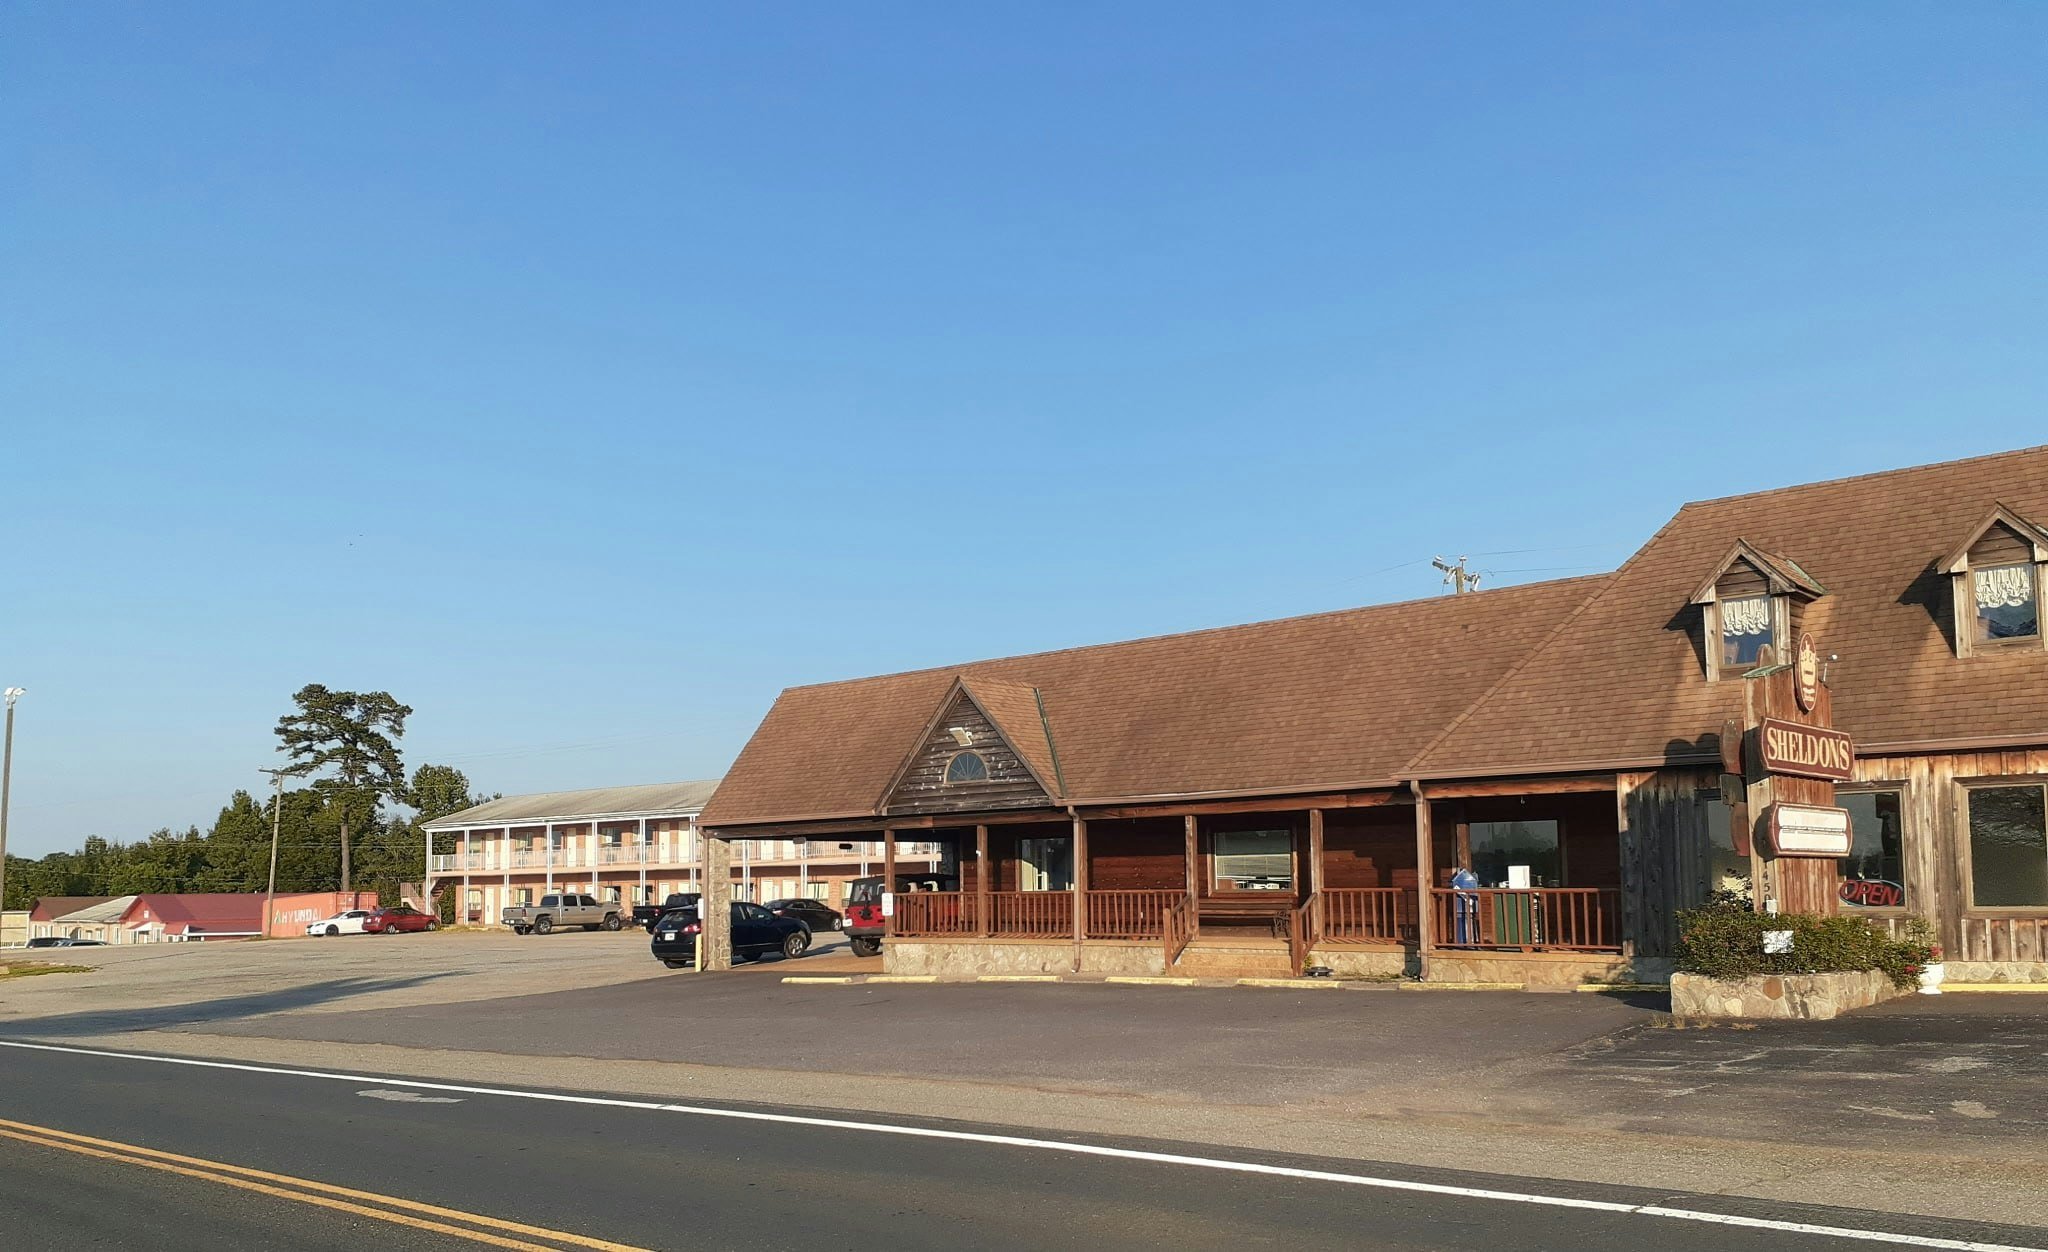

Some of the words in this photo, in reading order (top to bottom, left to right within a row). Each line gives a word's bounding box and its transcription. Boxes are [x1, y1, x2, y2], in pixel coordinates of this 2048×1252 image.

[1767, 727, 1850, 771] SHELDON'S
[1840, 880, 1900, 906] OPEN
[281, 908, 322, 924] HYUNDAI
